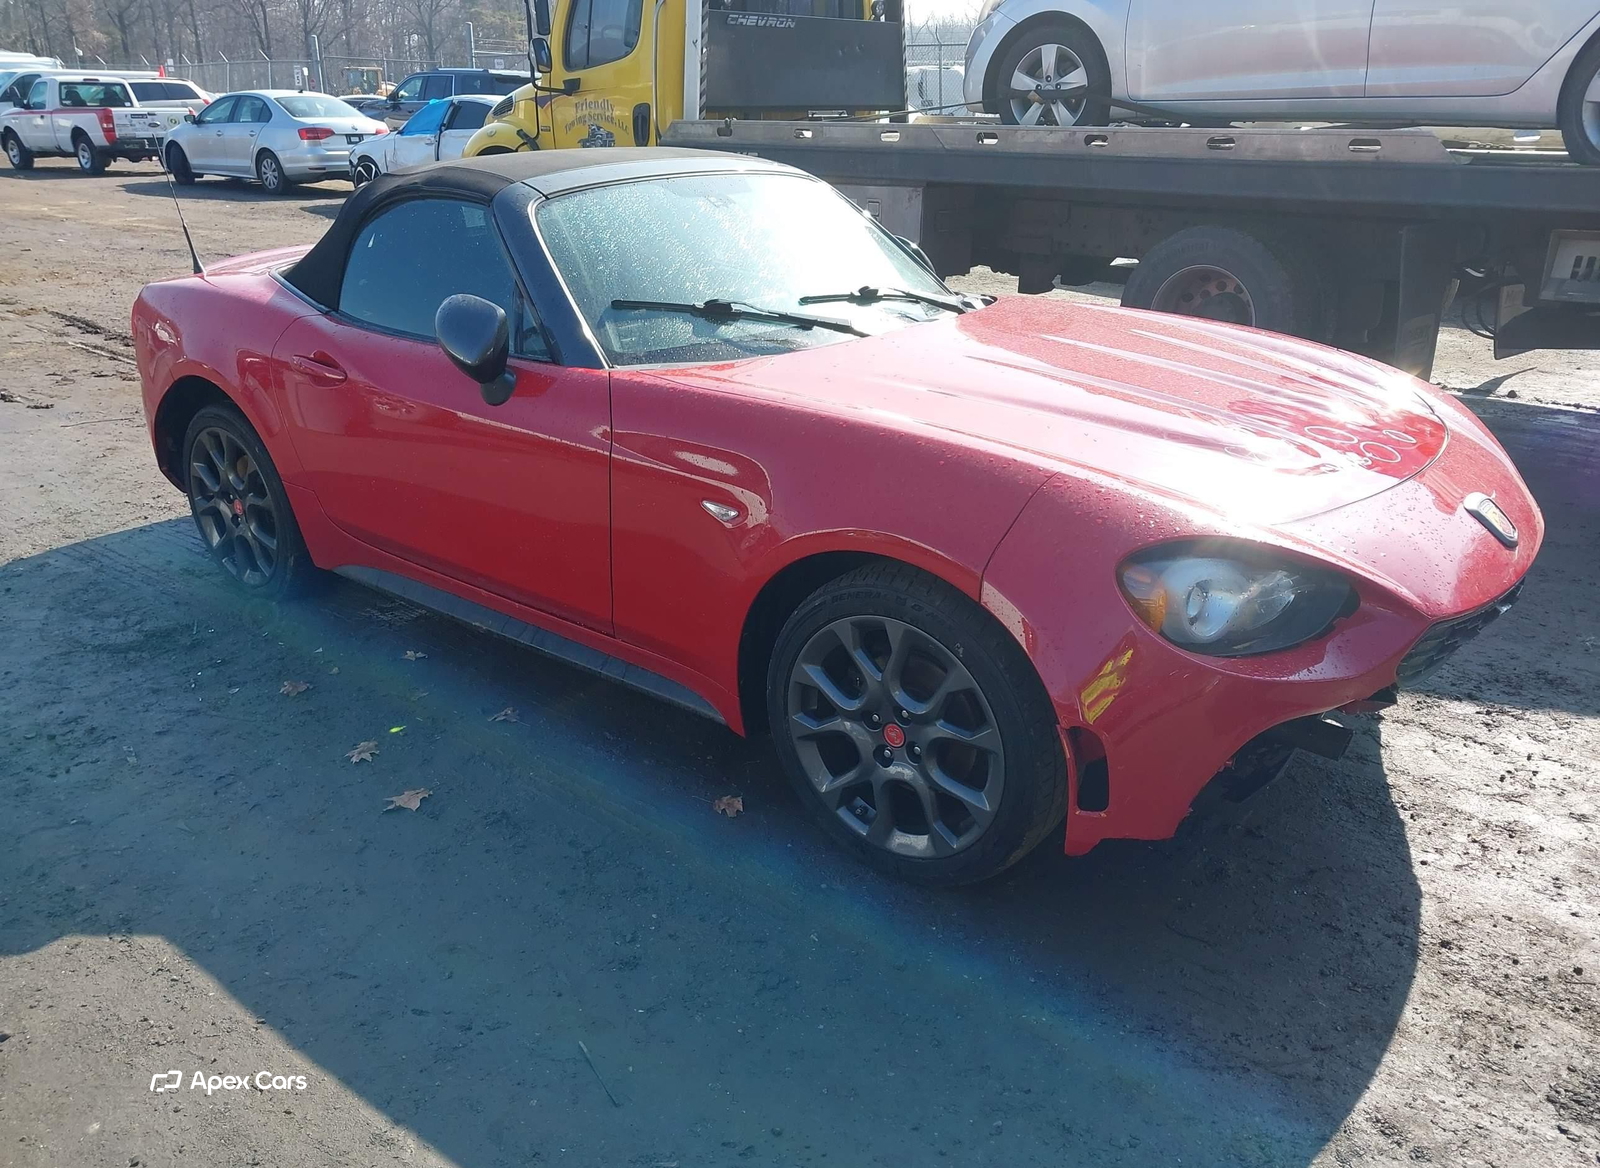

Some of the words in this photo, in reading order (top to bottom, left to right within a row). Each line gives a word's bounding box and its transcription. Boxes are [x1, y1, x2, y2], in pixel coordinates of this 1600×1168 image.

[726, 14, 796, 28] CHEVRON
[574, 98, 616, 114] Friendly
[564, 114, 587, 135] Towing
